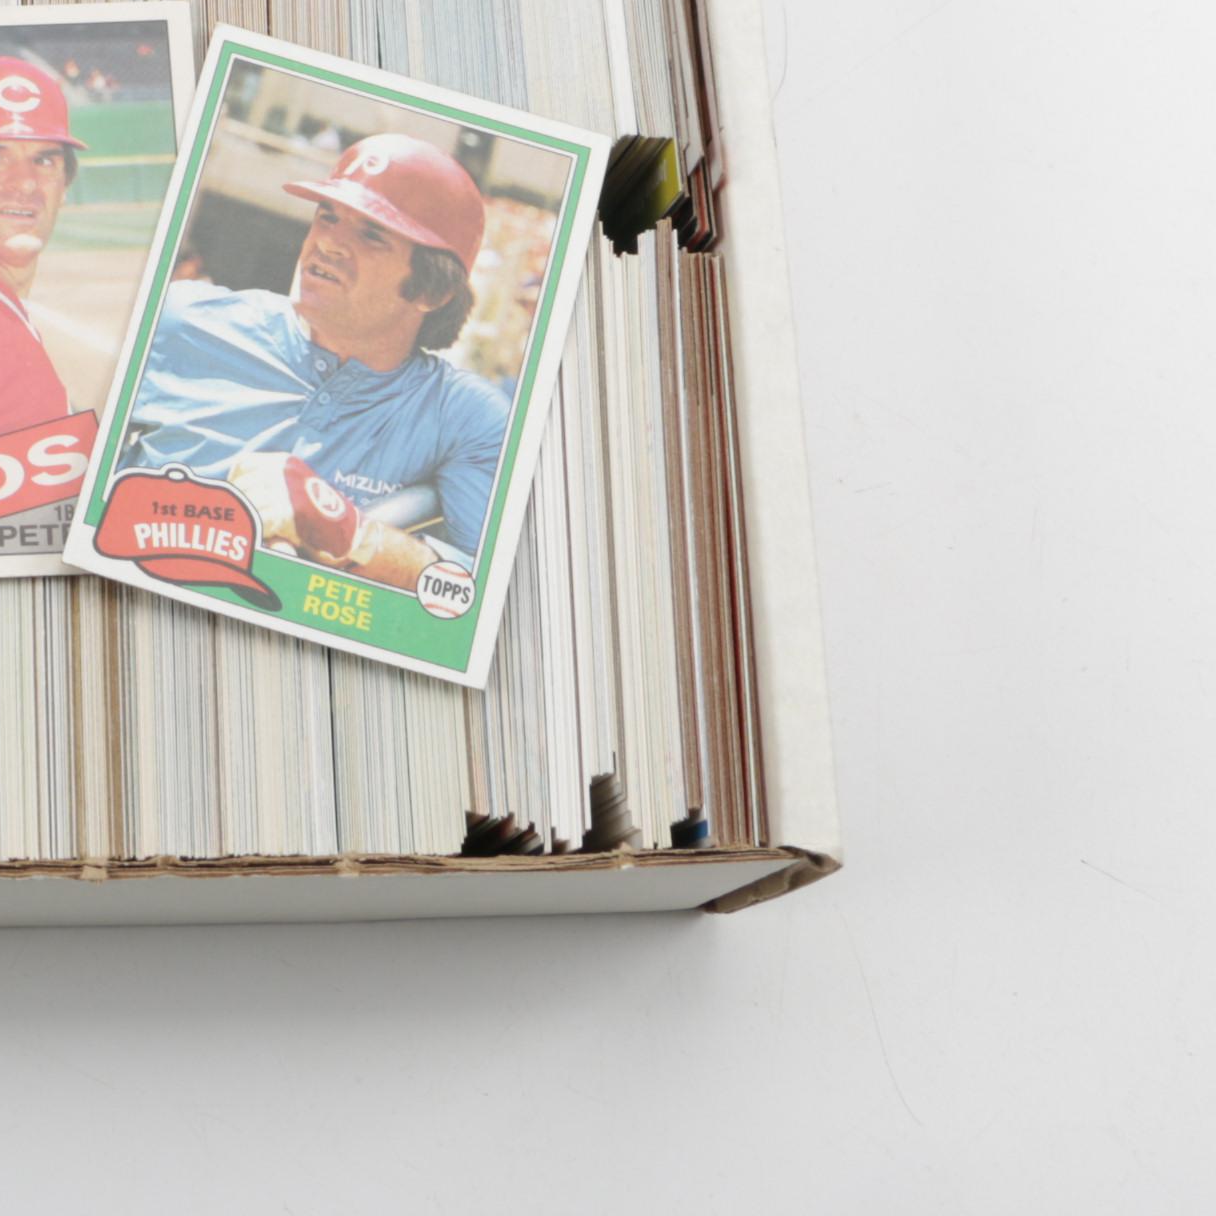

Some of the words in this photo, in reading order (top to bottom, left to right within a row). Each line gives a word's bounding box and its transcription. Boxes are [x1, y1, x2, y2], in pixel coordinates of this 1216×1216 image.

[334, 468, 403, 496] MIZUN
[151, 500, 177, 516] 1st
[183, 503, 235, 522] BASE
[134, 522, 249, 562] PHILLIES
[307, 573, 373, 609] PETE
[422, 574, 472, 605] TOPPS
[302, 594, 373, 632] ROSE
